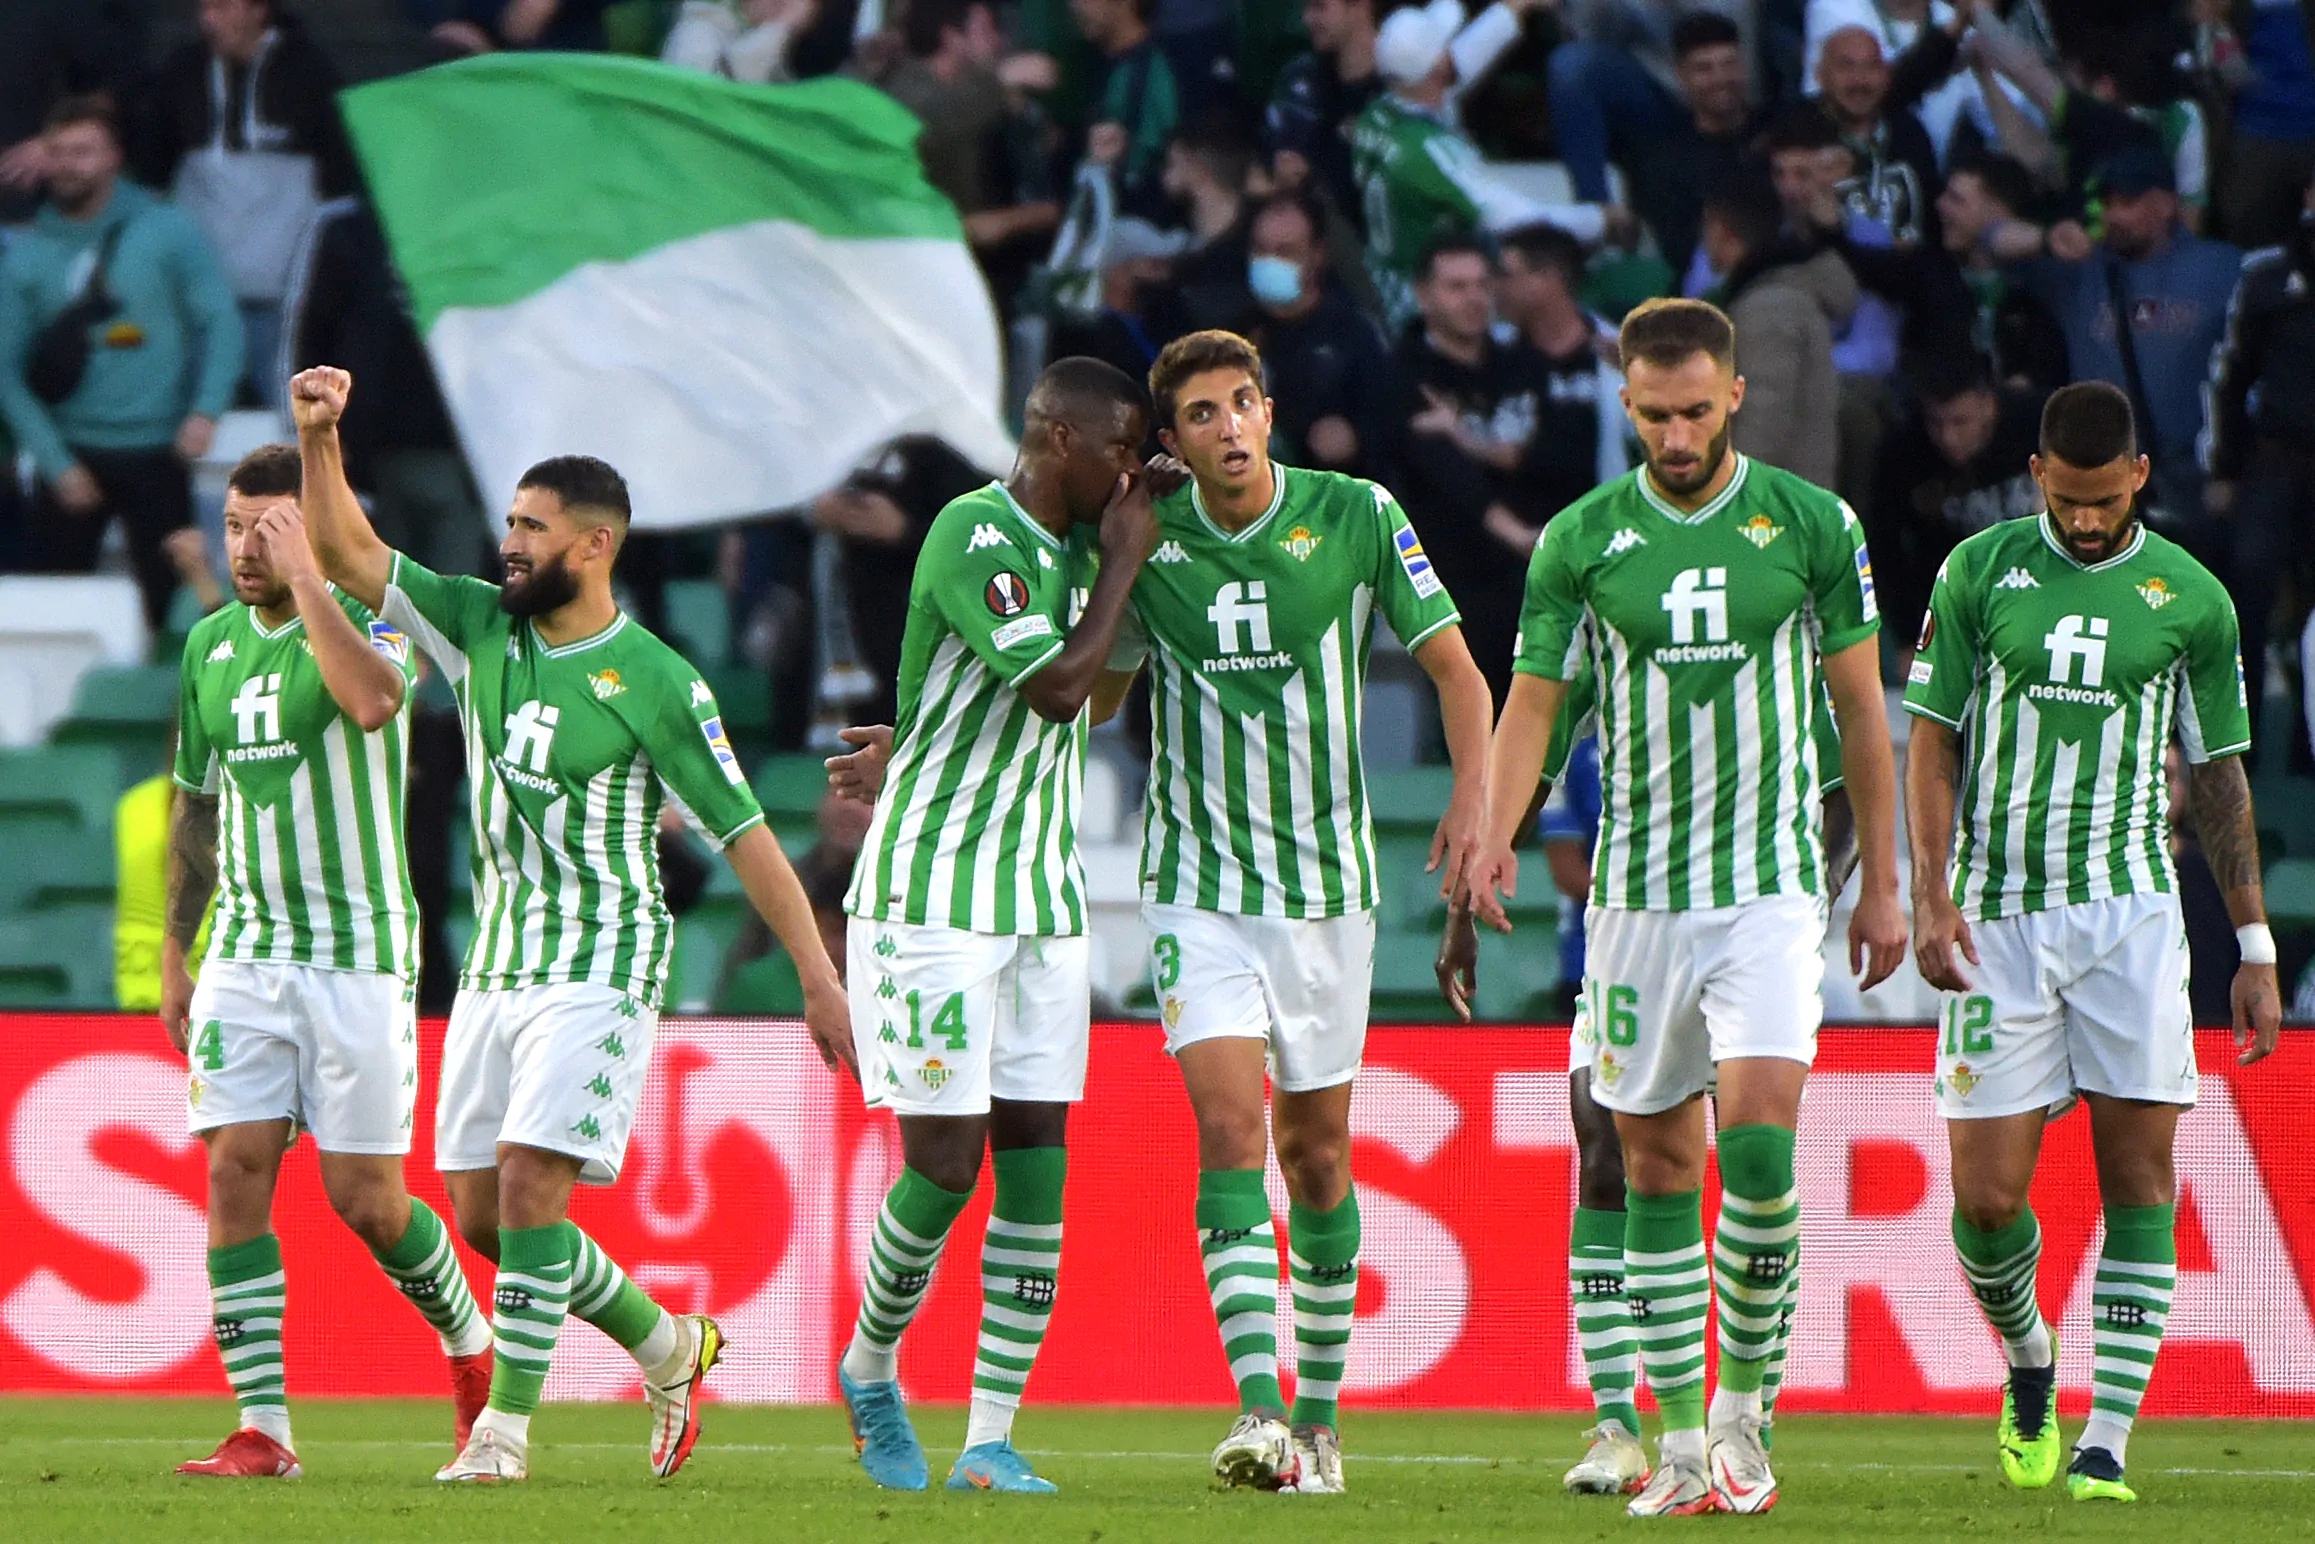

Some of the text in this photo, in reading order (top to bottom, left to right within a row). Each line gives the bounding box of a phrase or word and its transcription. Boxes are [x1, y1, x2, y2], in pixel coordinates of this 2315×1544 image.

[1207, 580, 1272, 654] fi
[1661, 566, 1728, 644] fi
[1202, 650, 1294, 673] network
[1654, 641, 1747, 663] network
[2043, 615, 2109, 688] fi
[231, 672, 281, 744] fi
[2028, 682, 2118, 707] network
[227, 740, 298, 762] network
[503, 700, 559, 774] fi
[1154, 933, 1180, 991] 3
[188, 1018, 224, 1070] 4
[906, 988, 967, 1051] 14
[1945, 994, 1995, 1055] 12
[1266, 1065, 2314, 1398] SRA
